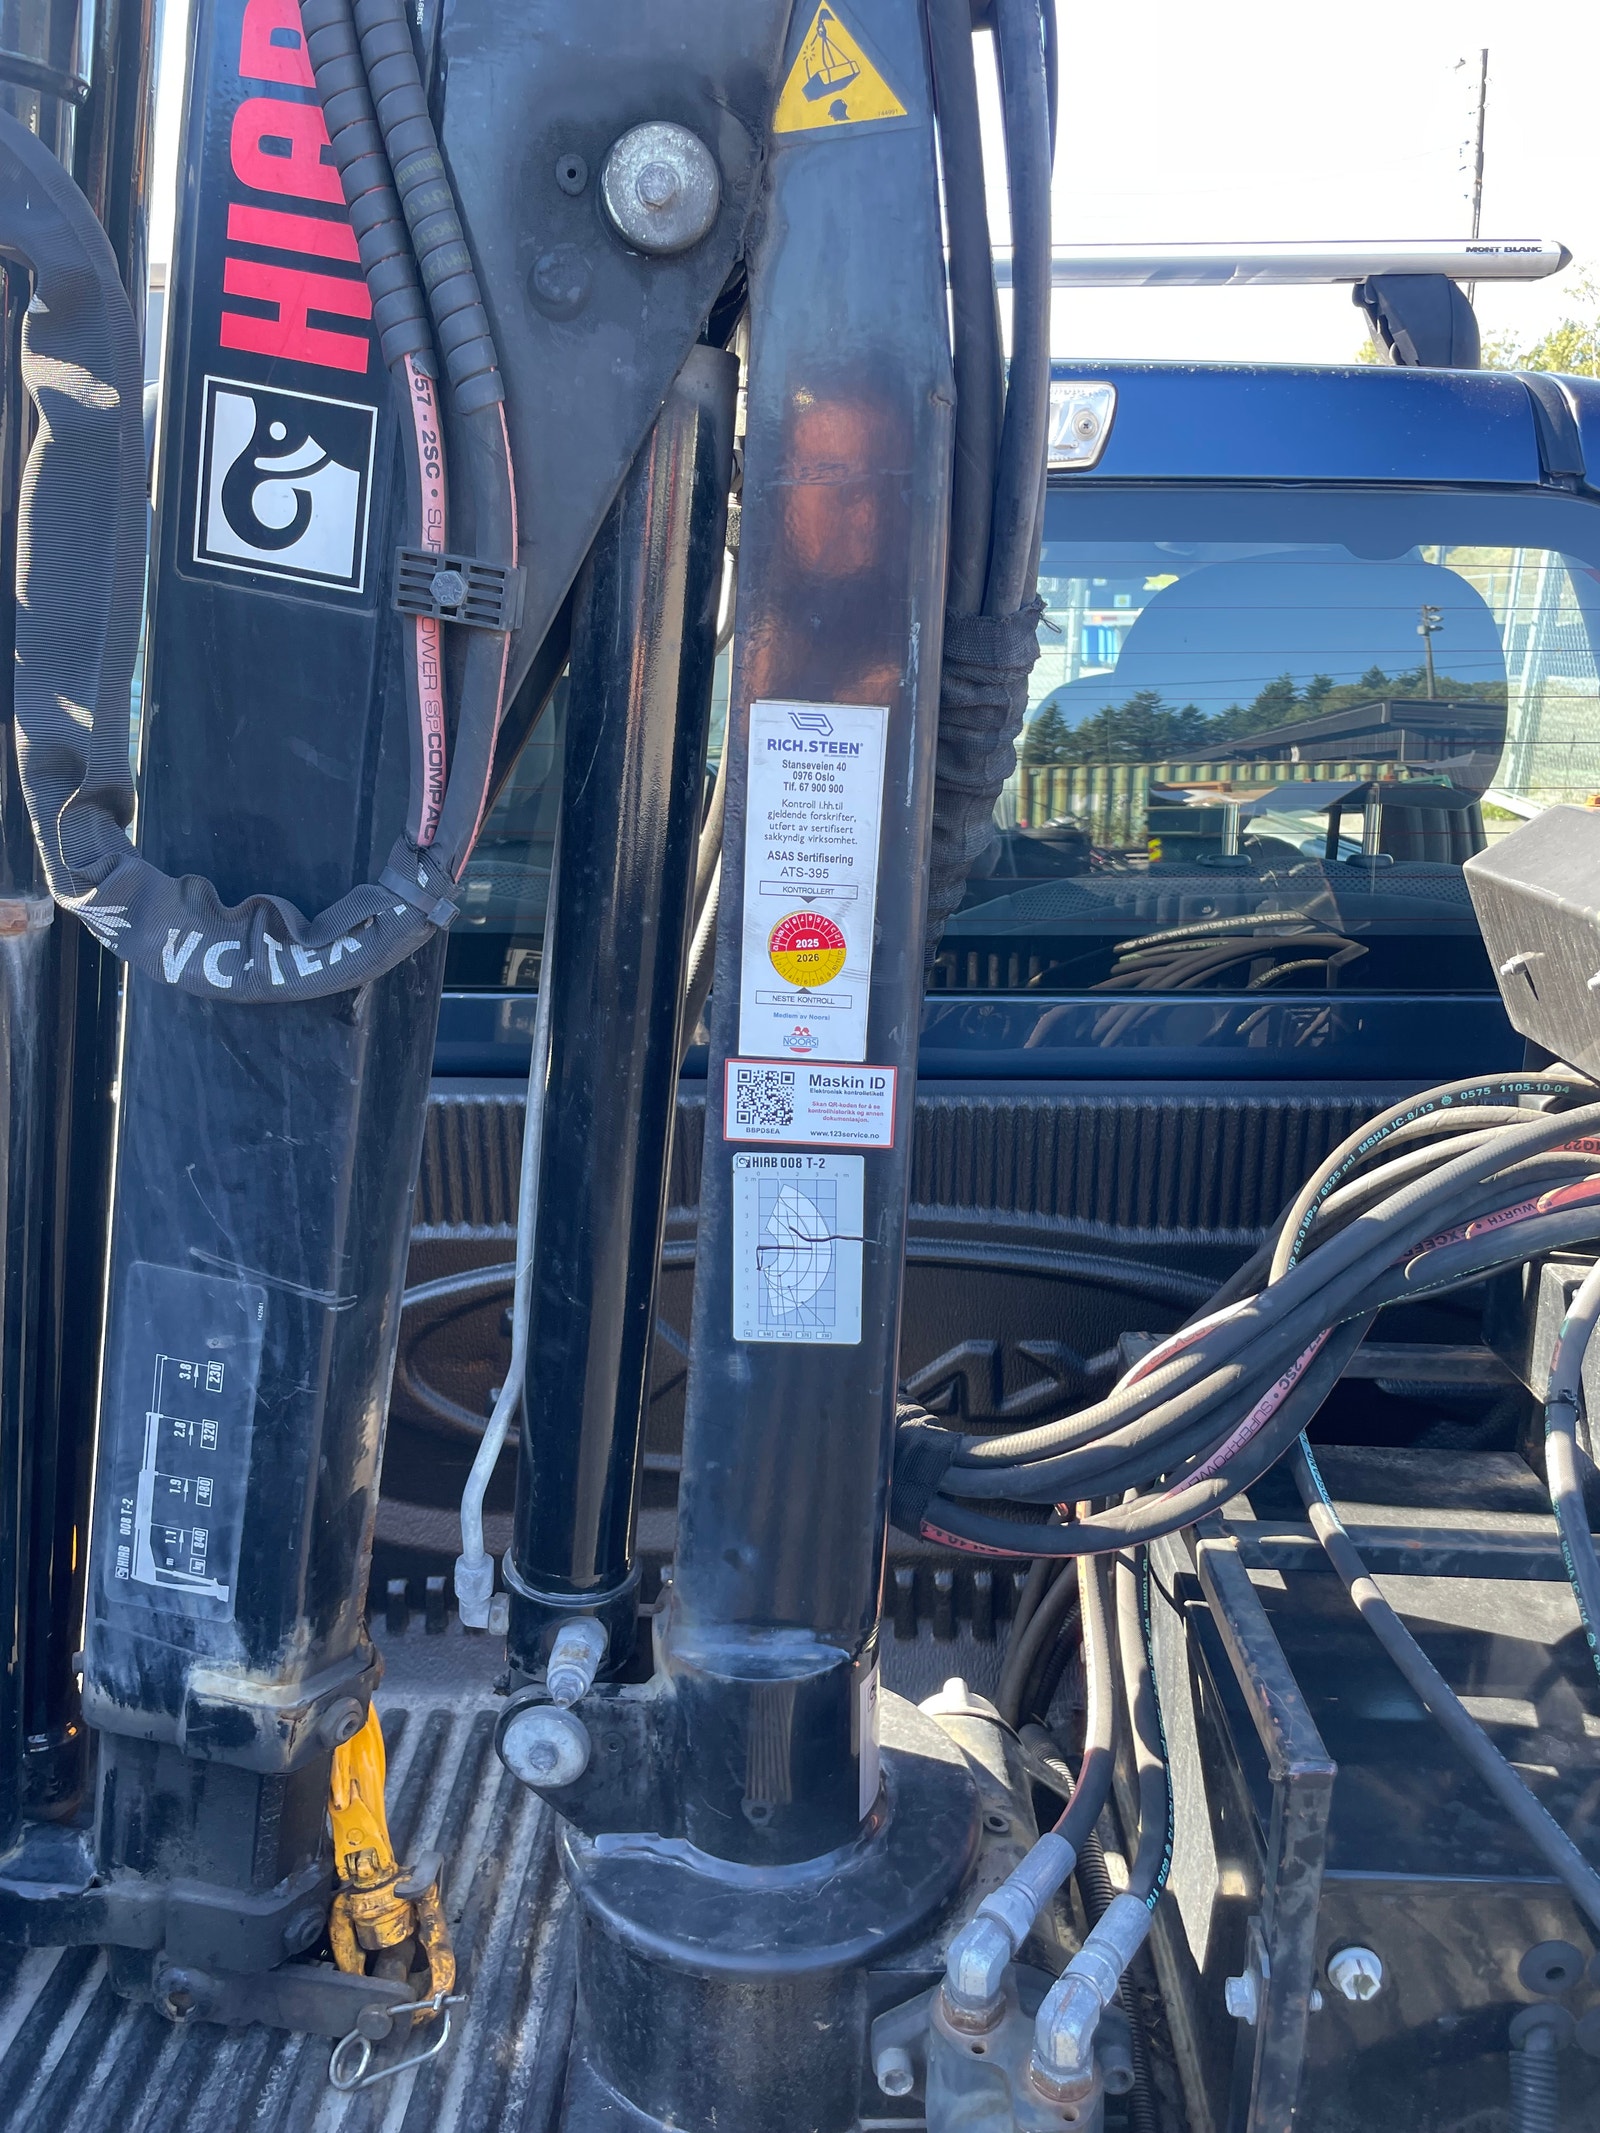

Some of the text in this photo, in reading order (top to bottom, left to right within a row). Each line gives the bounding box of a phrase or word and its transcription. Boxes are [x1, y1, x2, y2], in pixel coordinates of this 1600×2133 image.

[422, 430, 441, 479] 2SC
[767, 738, 860, 755] RICH.STEEN
[782, 759, 847, 772] Stanseveien 40
[793, 770, 835, 782] 0976 Oslo
[783, 781, 844, 794] Tlf. 67 900 900
[781, 799, 816, 809] Kontroll
[767, 809, 807, 820] gjeldende
[811, 824, 853, 834] sertifisert
[764, 832, 858, 845] sakkyndig virksomhet.
[767, 850, 854, 866] ASAS Sertifisering
[780, 867, 829, 879] ATS-395
[782, 886, 835, 895] KONTROLLERT
[796, 938, 819, 948] 2025
[796, 954, 819, 962] 2026
[772, 994, 835, 1005] NESTE KONTROLL
[783, 1036, 818, 1047] NOORSI
[809, 1074, 886, 1090] Maskin ID
[810, 1130, 880, 1139] www.123service.no
[752, 1156, 826, 1168] HIAB 008 T-2
[1302, 1204, 1318, 1228] MPa
[1320, 1170, 1341, 1196] 6525
[1358, 1126, 1390, 1154] MSHA
[1391, 1103, 1435, 1129] IC-8/13
[1460, 1086, 1491, 1100] 0575
[1500, 1082, 1570, 1094] 1105-10-04
[179, 1362, 192, 1380] 3.8
[210, 1363, 222, 1384] 230
[174, 1422, 186, 1438] 2.8
[204, 1422, 216, 1442] 320
[170, 1479, 181, 1495] 1.9
[199, 1479, 211, 1497] 480
[115, 1498, 134, 1568] HIAB 008 T-2
[165, 1530, 176, 1545] 1.1
[195, 1530, 206, 1549] 840
[1146, 1888, 1160, 1910] 110
